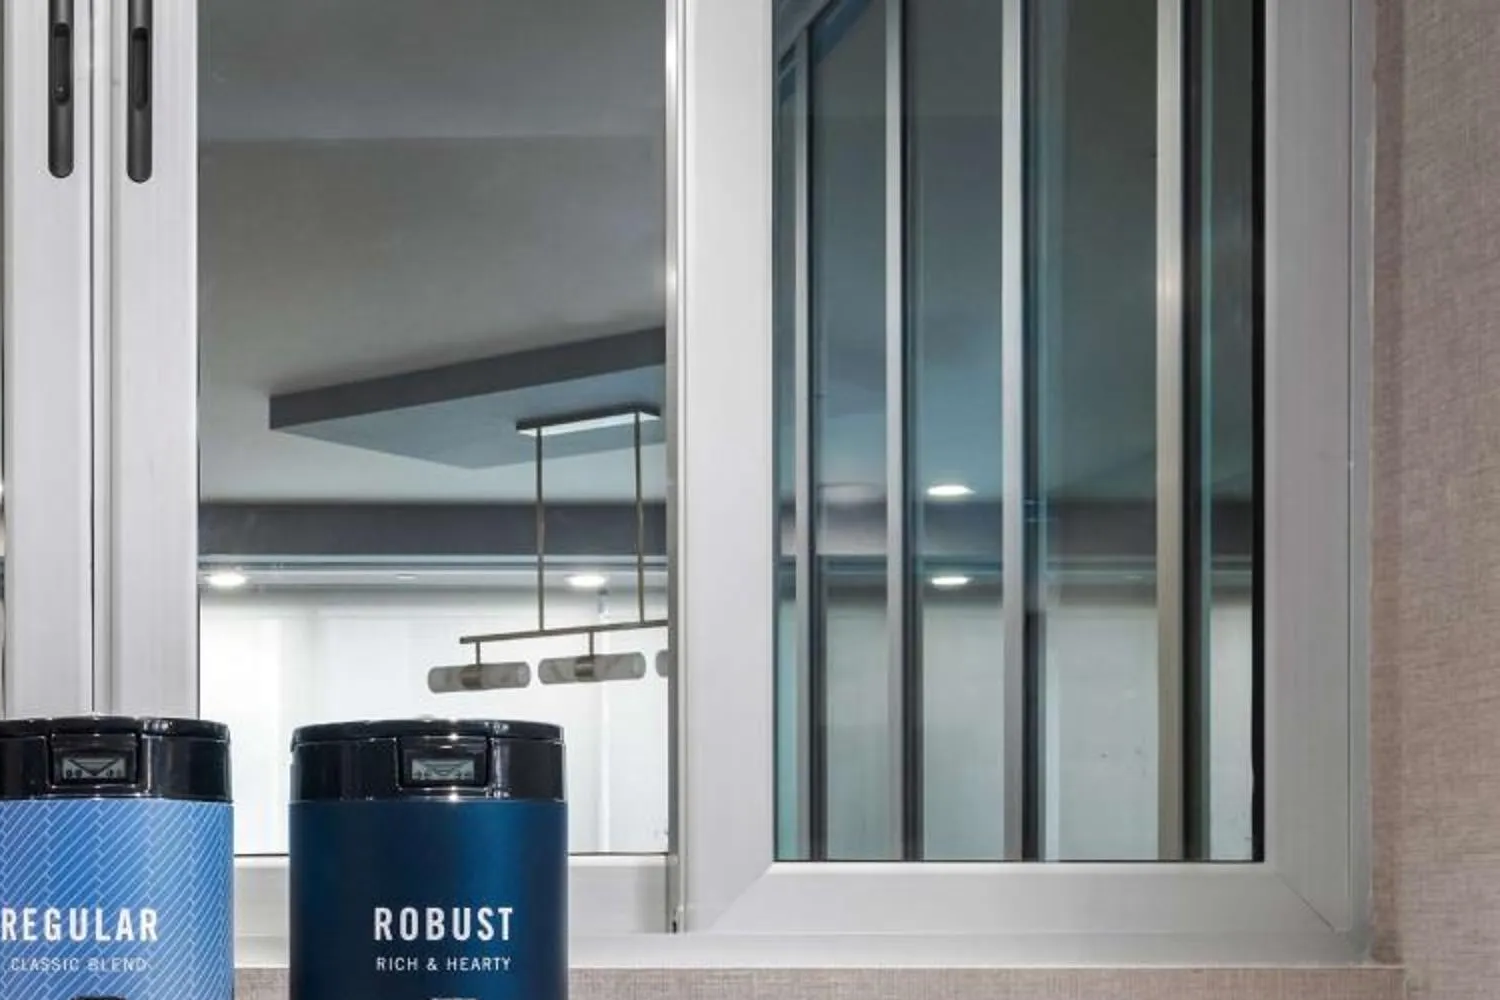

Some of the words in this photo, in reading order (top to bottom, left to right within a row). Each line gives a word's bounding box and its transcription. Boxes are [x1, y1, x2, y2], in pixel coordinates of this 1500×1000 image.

[1, 907, 158, 942] REGULAR
[374, 907, 513, 941] ROBUST
[10, 956, 80, 972] CLASSIC
[88, 956, 147, 972] BLEND
[375, 956, 419, 972] RICH
[426, 956, 438, 972] &
[446, 956, 512, 972] HEARTY
